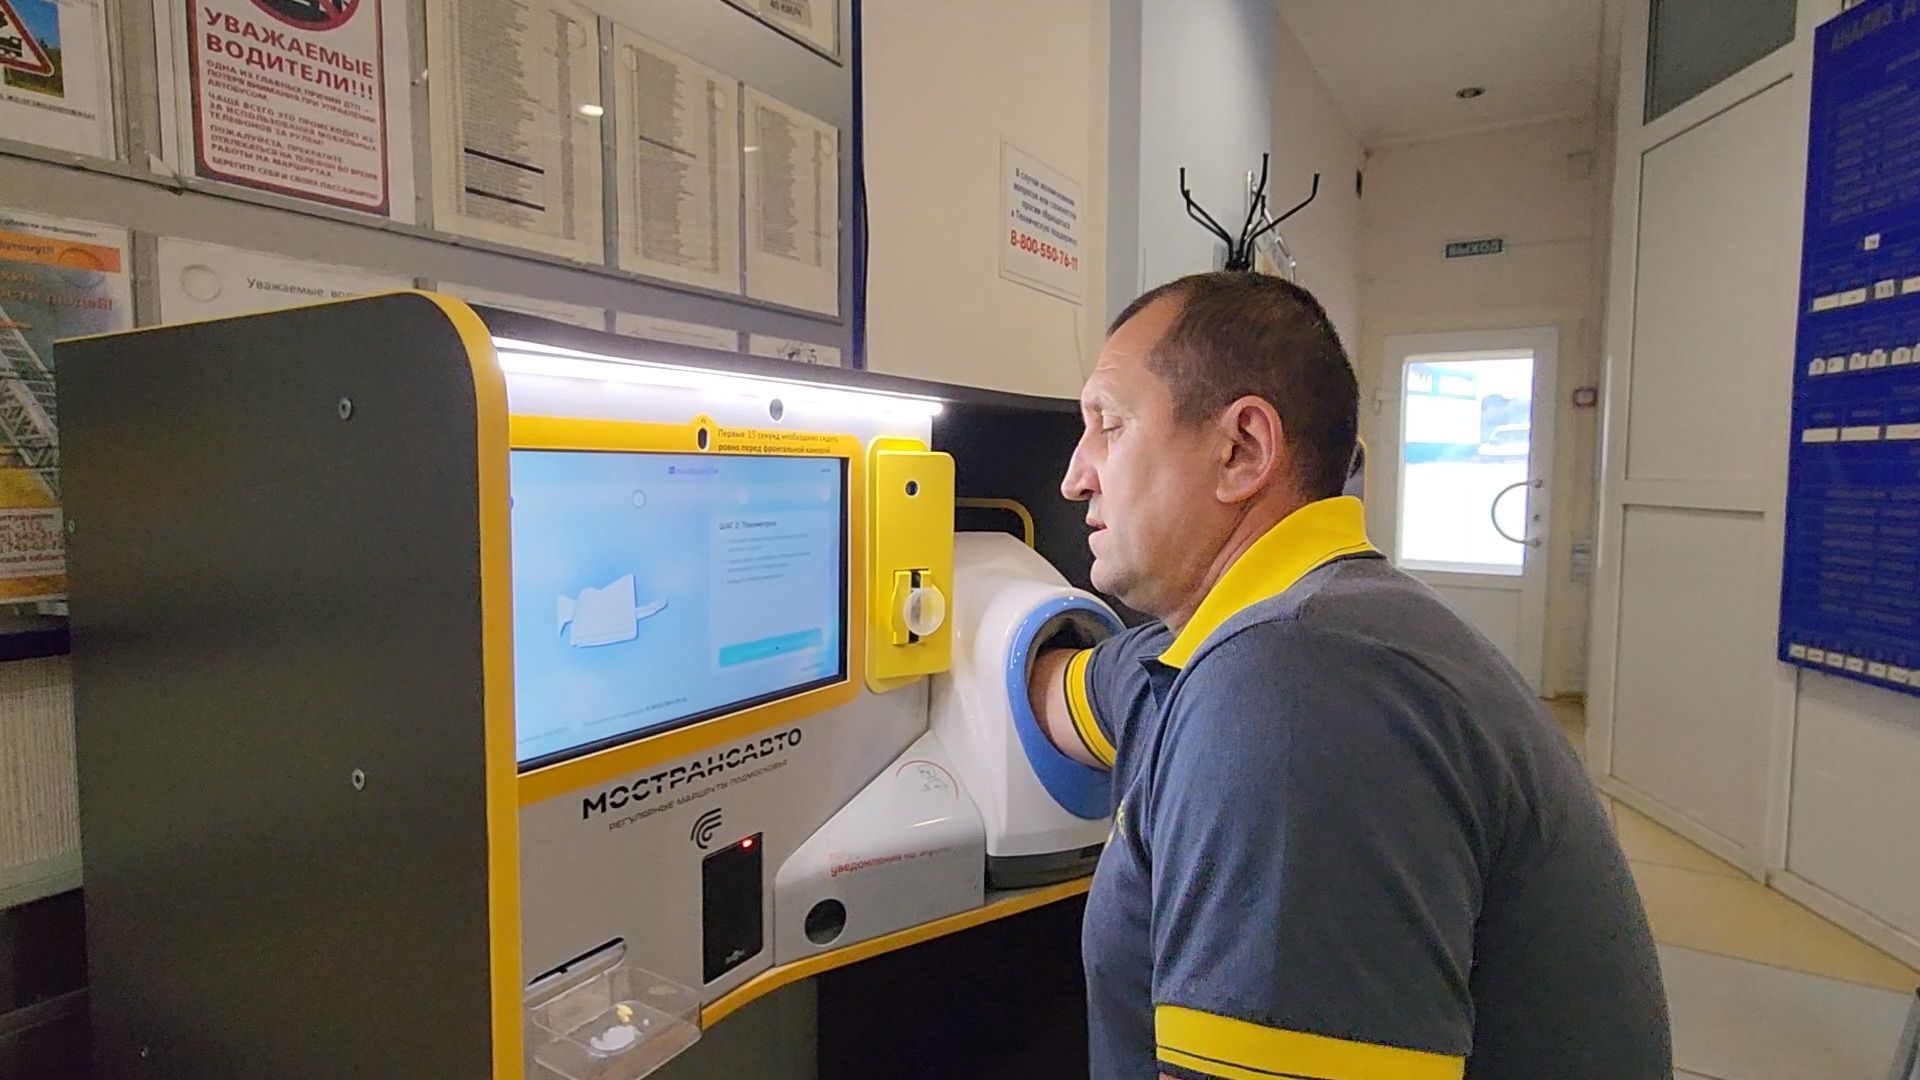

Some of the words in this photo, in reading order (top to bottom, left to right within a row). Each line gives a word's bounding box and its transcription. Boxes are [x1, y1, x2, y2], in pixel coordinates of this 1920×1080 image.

[204, 6, 373, 79] УВАЖАЕМЫЕ
[206, 33, 373, 101] ВОДИТЕЛИ!!!
[206, 59, 236, 75] ОДНА
[239, 69, 252, 79] ИЗ
[255, 74, 301, 93] ГЛАВНЫХ
[304, 88, 340, 105] ПРИЧИН
[344, 100, 360, 110] ДТП
[207, 68, 244, 86] ПОТЕРЯ
[246, 80, 299, 101] ВНИМАНИЯ
[302, 96, 318, 107] ПРИ
[322, 102, 375, 123] УПРАВЛЕНИИ
[208, 91, 239, 106] ЧАЩЕ
[243, 100, 274, 116] ВСЕГО
[278, 110, 294, 121] ЭТО
[298, 116, 358, 139] ПРОИСХОДИТ
[209, 110, 271, 133] ТЕЛЕФОНОВ
[275, 127, 286, 136] ЗА
[210, 102, 222, 112] ЗА
[225, 106, 314, 136] ИСПОЛЬЗОВАНИЯ
[317, 130, 375, 151] МОБИЛЬНЫХ
[210, 133, 277, 156] ОТВЛЕКАТЬСЯ
[280, 150, 291, 159] НА
[295, 154, 335, 170] ТЕЛЕФОН
[337, 164, 348, 173] ВО
[350, 167, 377, 180] ВРЕМЯ
[211, 143, 252, 159] РАБОТЫ
[255, 153, 269, 163] НА
[212, 156, 254, 173] БЕРЕГИТЕ
[257, 166, 279, 178] СЕБЯ
[289, 173, 317, 186] СВОИХ
[287, 143, 341, 163] ПРЕКРАТИТЕ
[1010, 229, 1079, 272] 8-800-550-76-11
[1449, 240, 1500, 256] ВЫХОД
[247, 277, 325, 297] Уважаемые
[718, 428, 745, 439] Первые
[747, 430, 757, 439] 15
[758, 431, 780, 441] секунд
[781, 432, 819, 442] необходимо
[718, 444, 740, 452] ровно
[741, 445, 762, 453] перед
[764, 445, 804, 454] фронтальной
[582, 728, 802, 819] МОСТРАНСАВТО
[608, 802, 673, 831] РЕГУЛЯРНЫЕ
[676, 783, 728, 806] МАРШРУТЫ
[729, 759, 788, 785] ПОДМОСКОВЬЯ
[830, 854, 902, 877] уведомления
